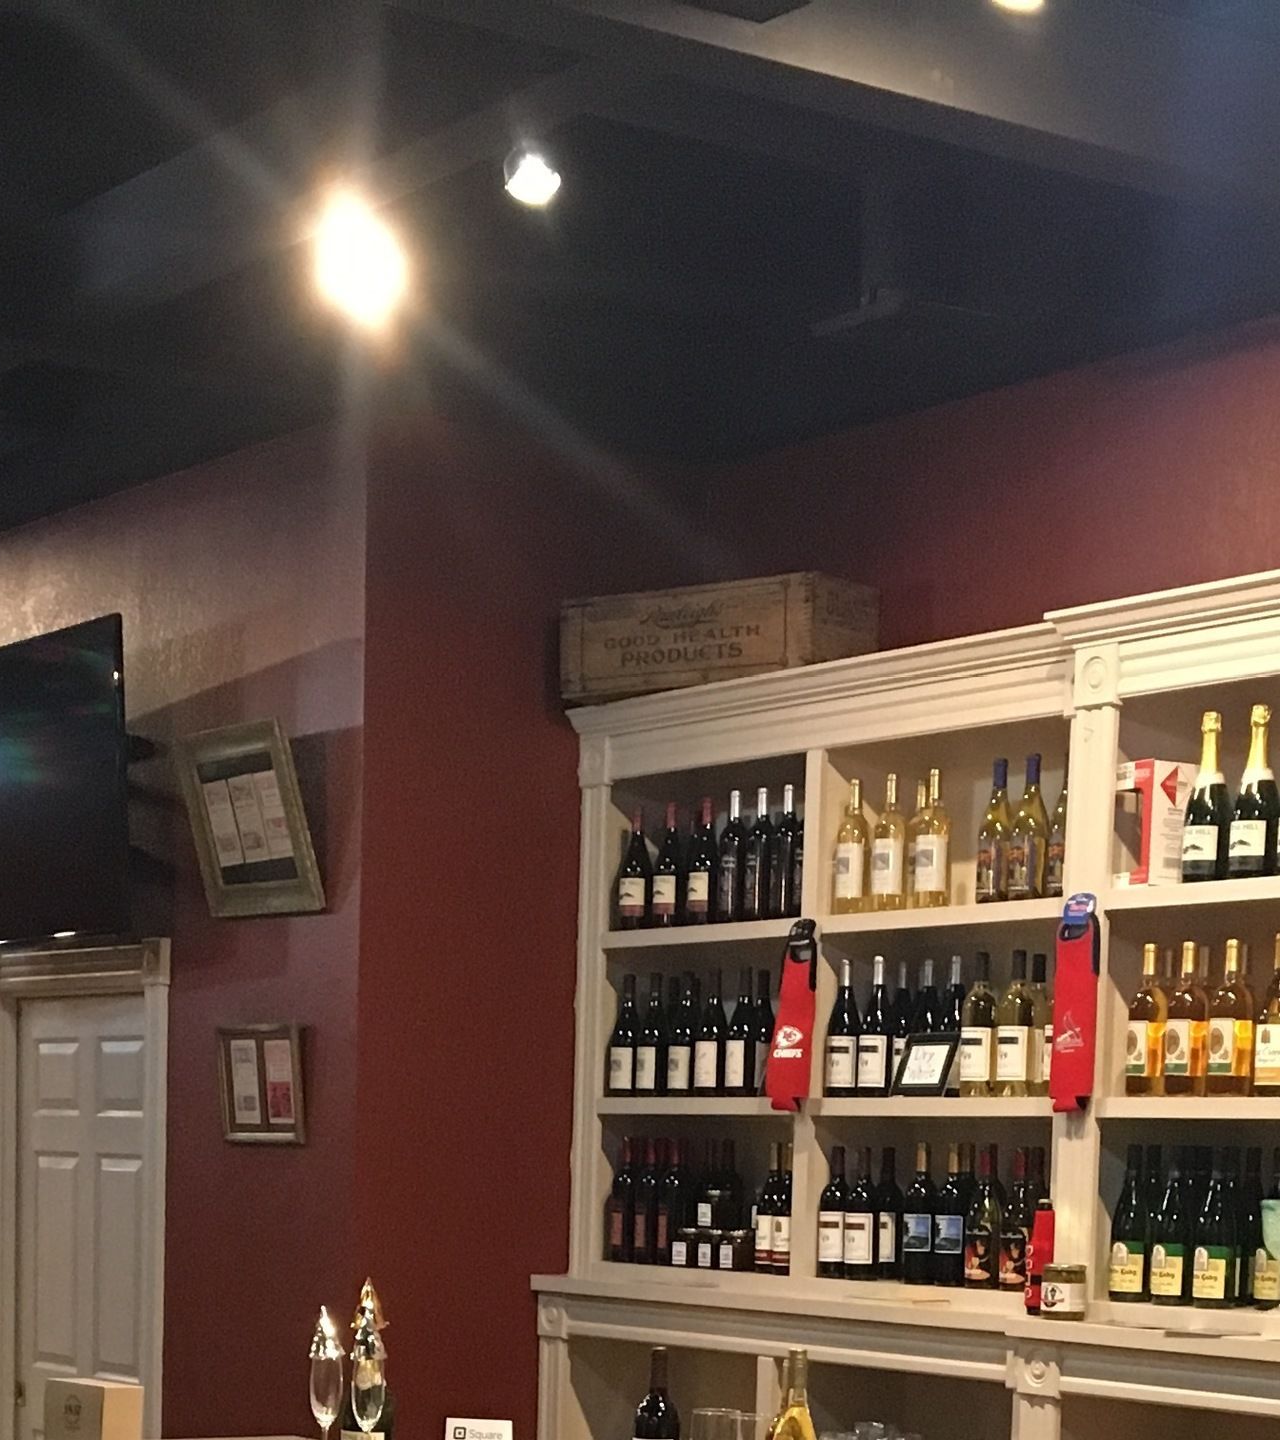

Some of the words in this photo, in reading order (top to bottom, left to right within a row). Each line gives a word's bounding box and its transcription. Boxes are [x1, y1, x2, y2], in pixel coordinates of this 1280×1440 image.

[604, 634, 661, 650] GOOD
[673, 624, 760, 644] HEALTH
[621, 642, 743, 667] PRODUCTS
[469, 1429, 503, 1440] Square
